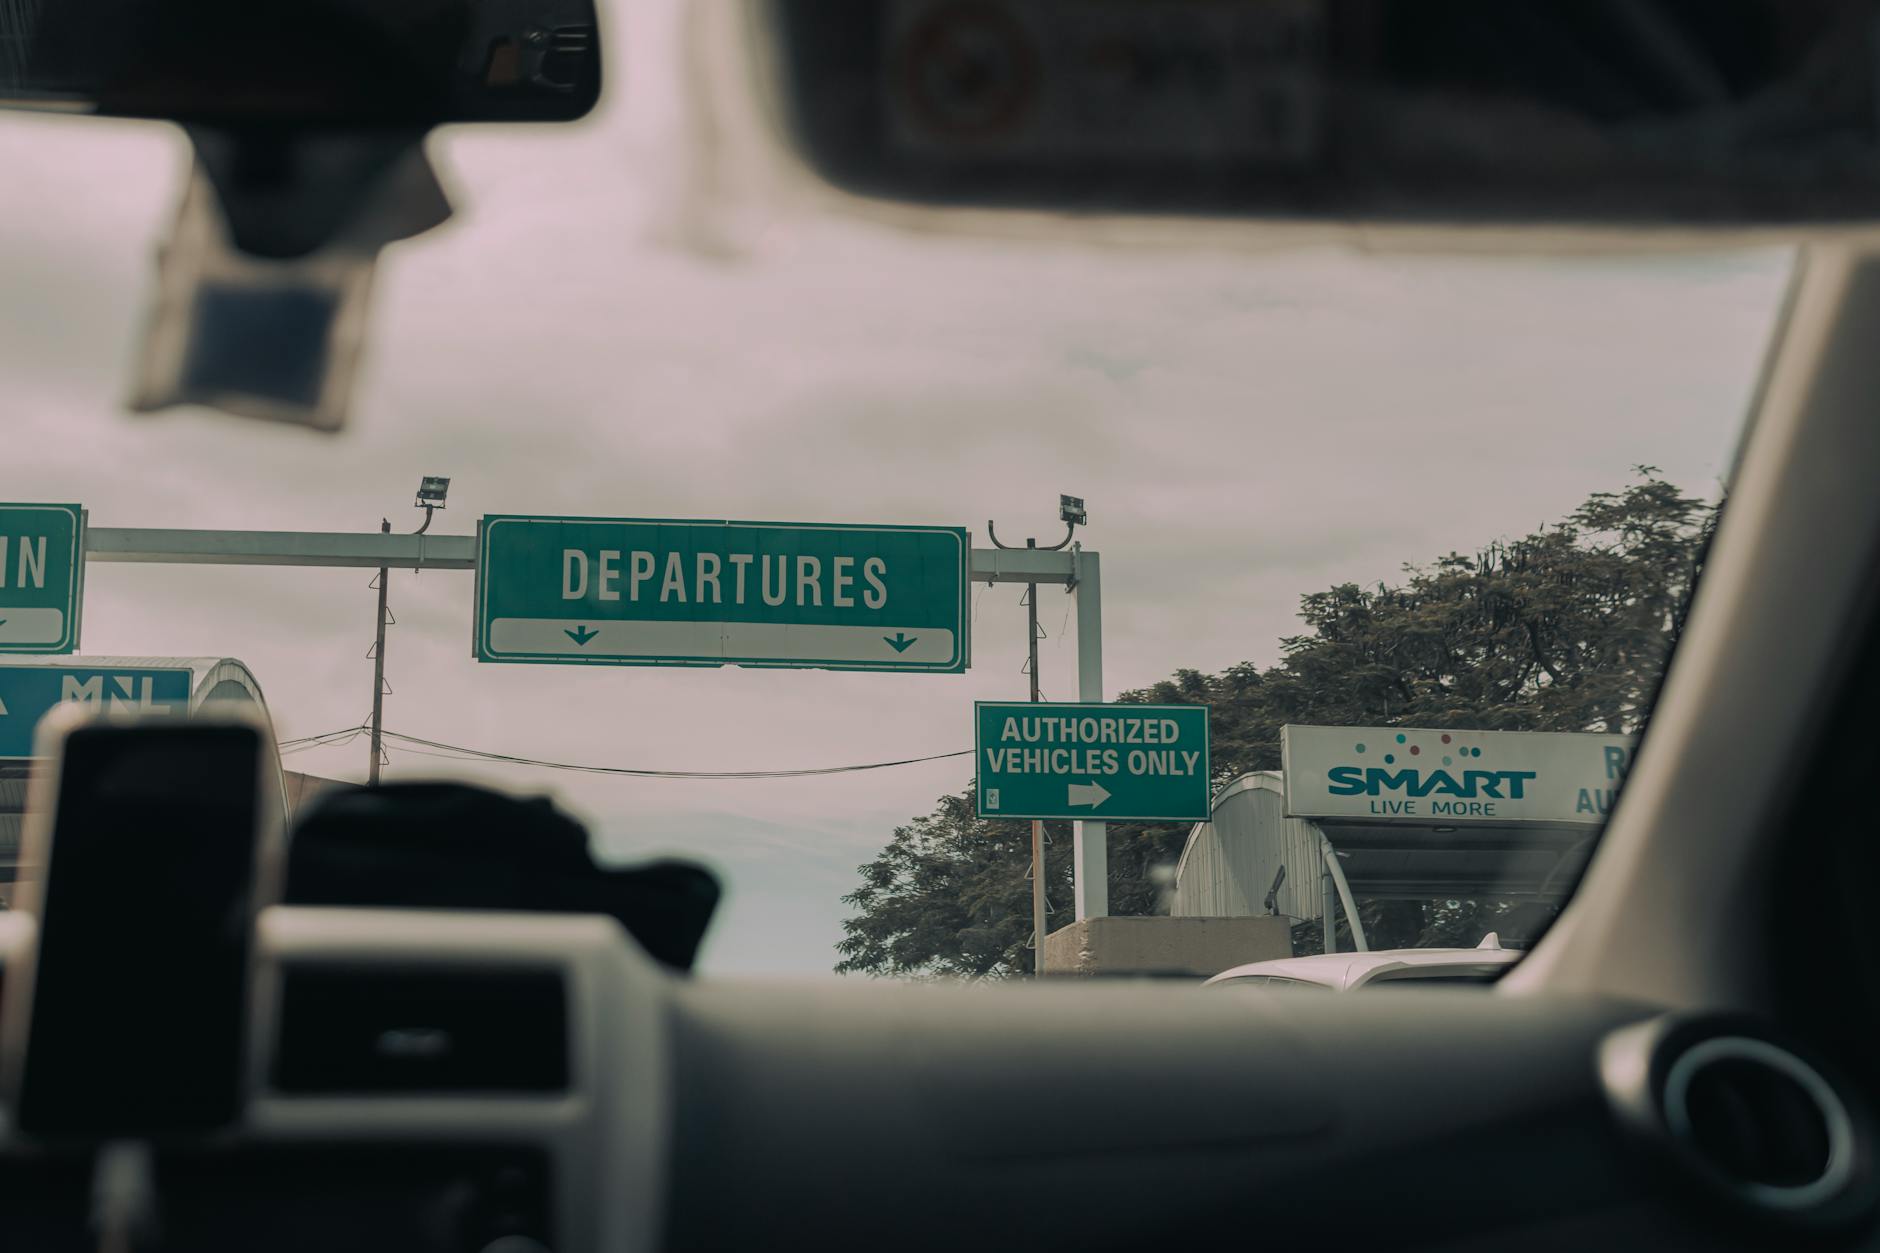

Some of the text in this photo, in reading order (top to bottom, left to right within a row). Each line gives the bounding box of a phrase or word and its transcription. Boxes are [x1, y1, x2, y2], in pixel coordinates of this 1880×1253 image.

[562, 548, 888, 609] DEPARTURES
[61, 675, 171, 716] MNL
[1001, 716, 1180, 744] AUTHORIZED
[986, 748, 1200, 776] VEHICLES ONLY
[1328, 766, 1537, 799] SMART
[1370, 800, 1496, 817] LIVE MORE
